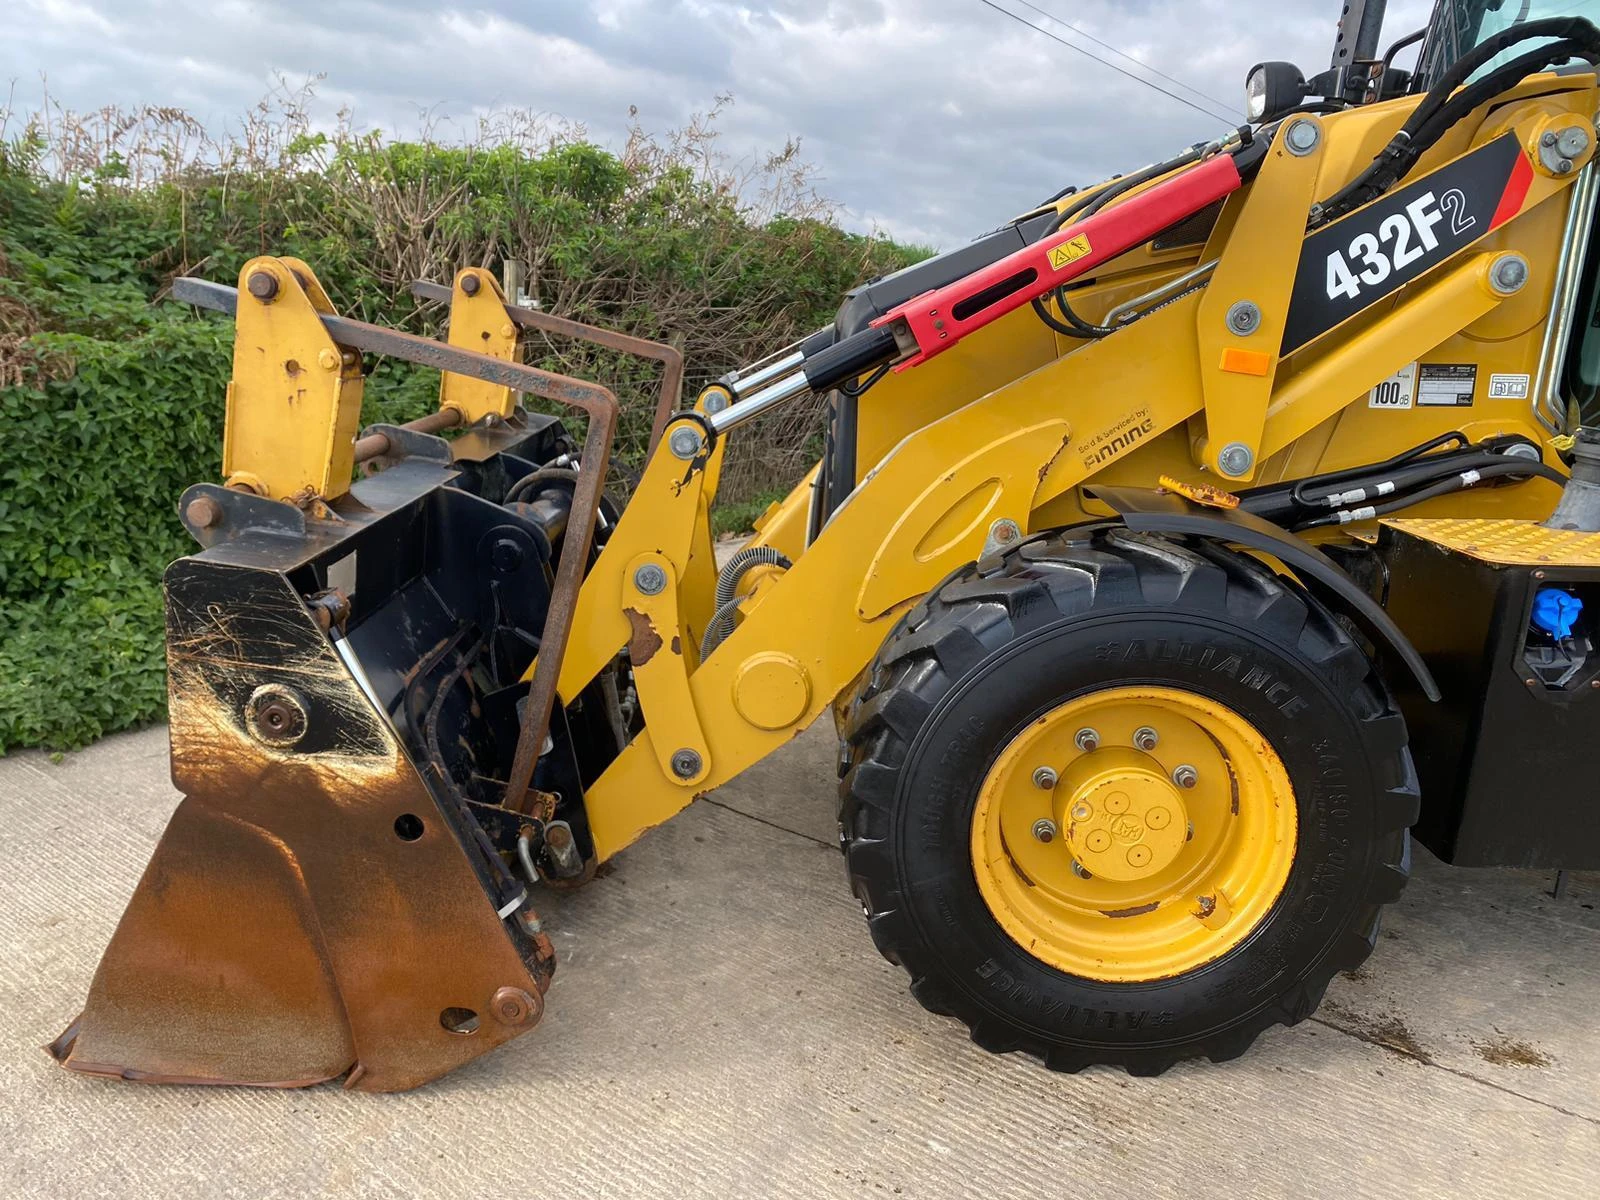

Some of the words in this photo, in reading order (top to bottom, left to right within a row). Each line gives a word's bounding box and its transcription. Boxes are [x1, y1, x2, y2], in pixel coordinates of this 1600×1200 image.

[1326, 188, 1476, 301] 432F2
[1103, 414, 1135, 438] Serviced
[1375, 382, 1400, 404] 100
[1122, 637, 1310, 720] ALLIANCE
[975, 957, 1150, 1032] ALLIANCE
